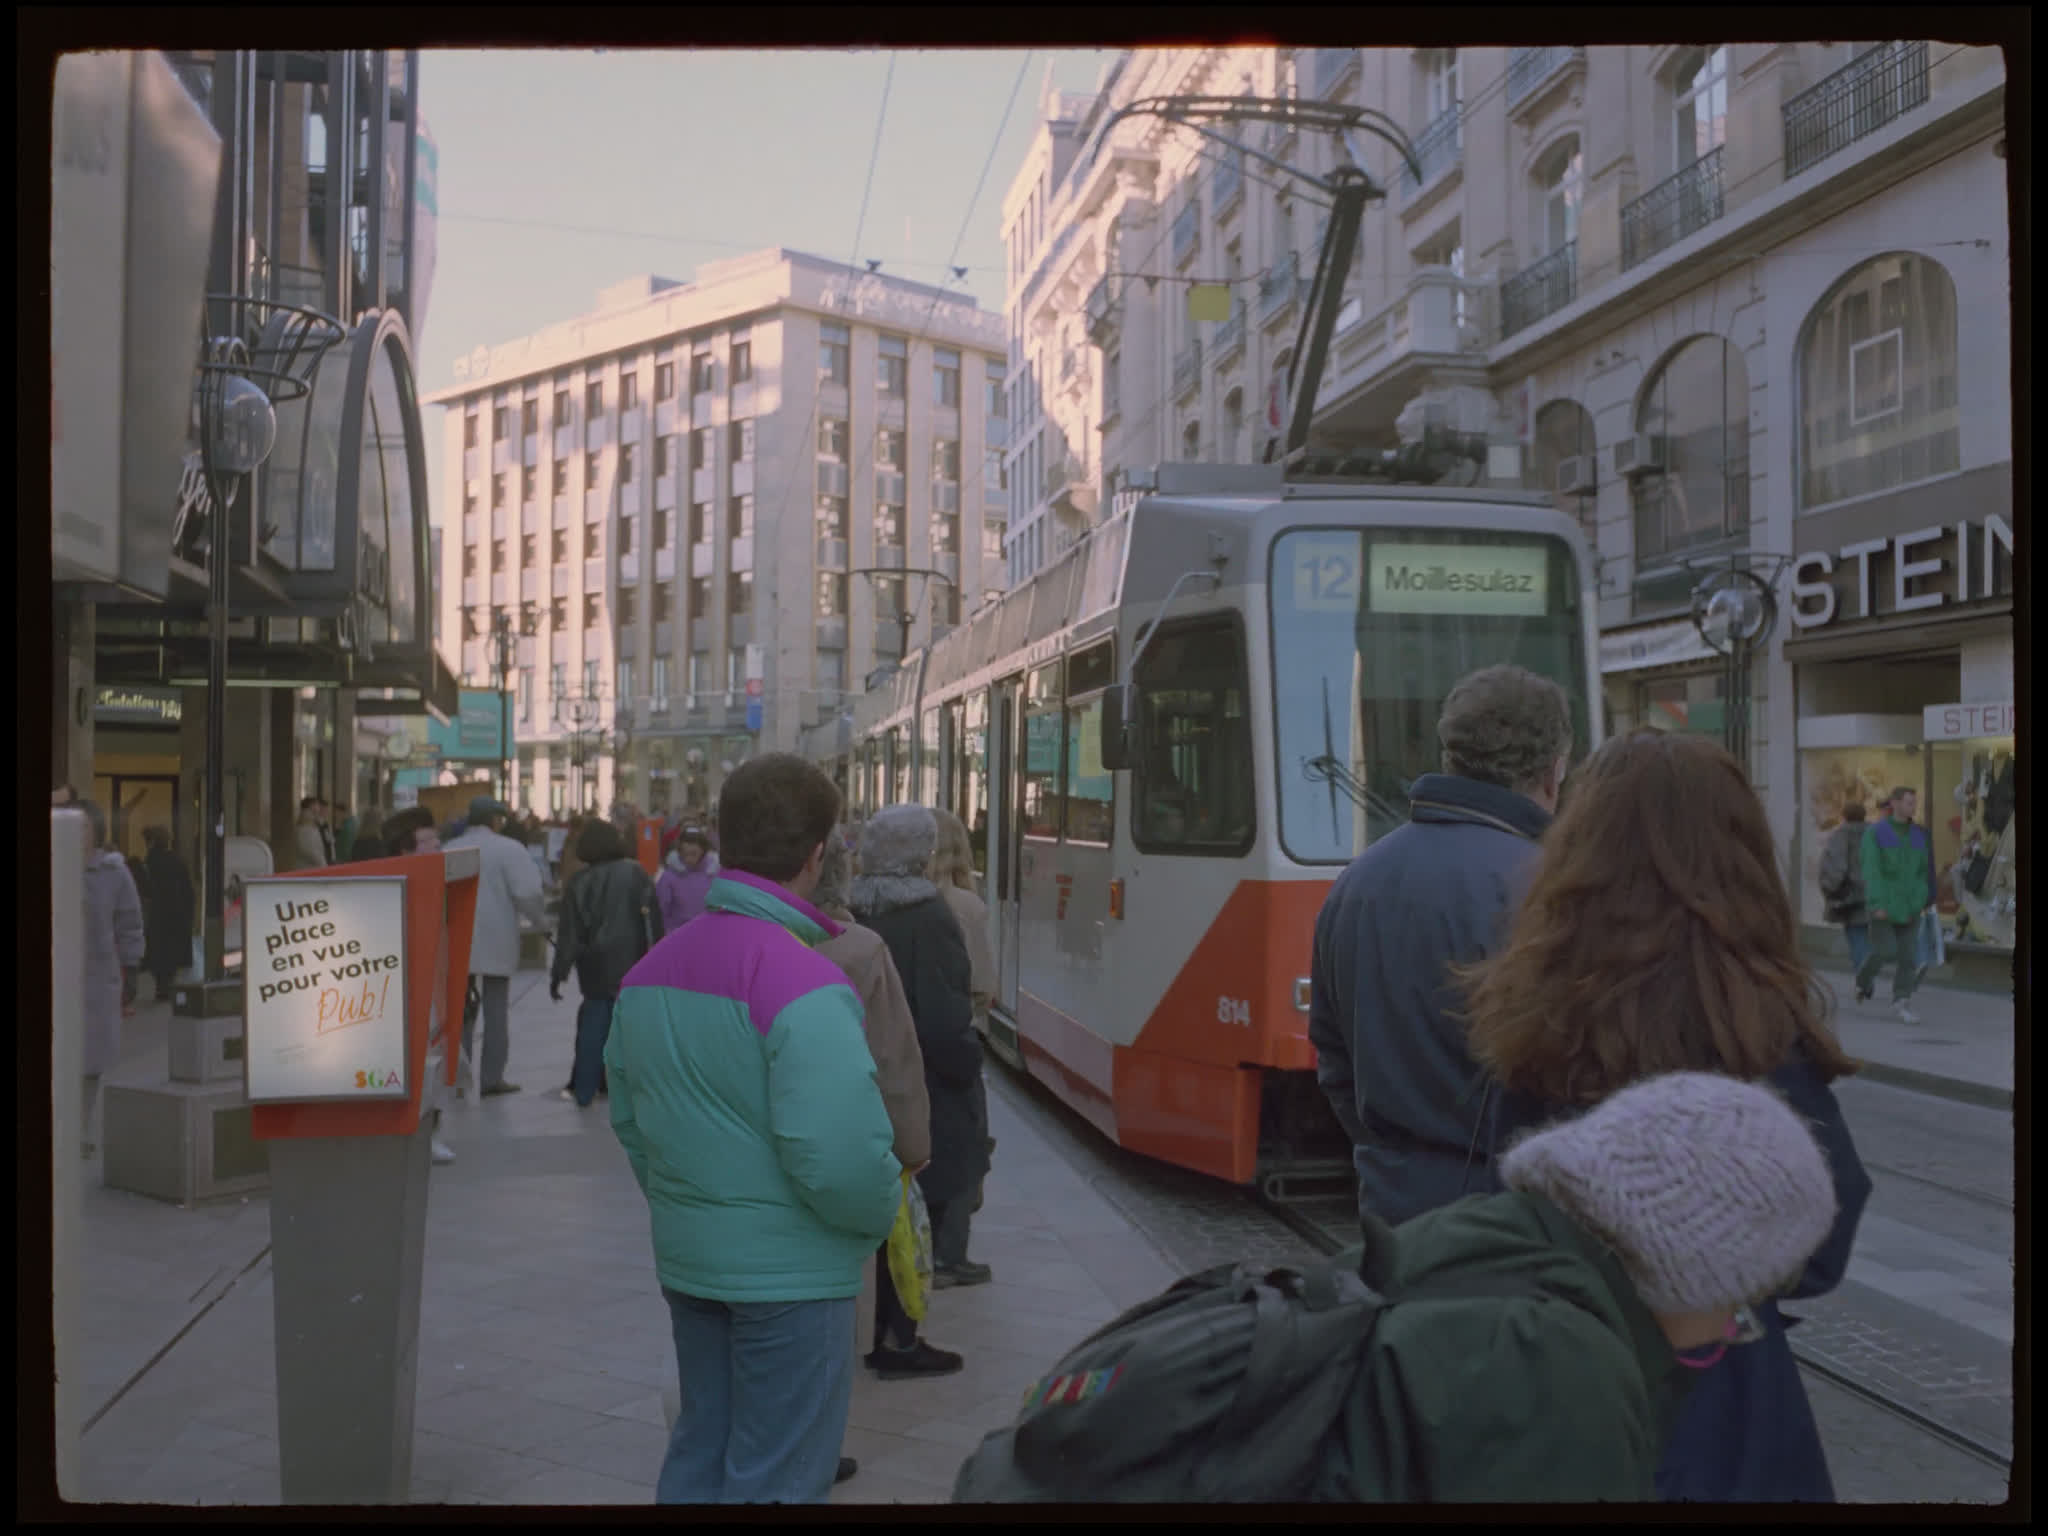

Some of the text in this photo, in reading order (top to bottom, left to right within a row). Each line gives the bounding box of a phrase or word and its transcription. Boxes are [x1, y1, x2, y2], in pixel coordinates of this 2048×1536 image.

[1300, 555, 1534, 598] 12 Moillesulaz
[275, 898, 329, 923] Une
[265, 921, 336, 954] place
[271, 938, 361, 973] en vue
[258, 954, 400, 1003] pour votre
[317, 975, 390, 1032] Pub!
[354, 1069, 401, 1089] SGA
